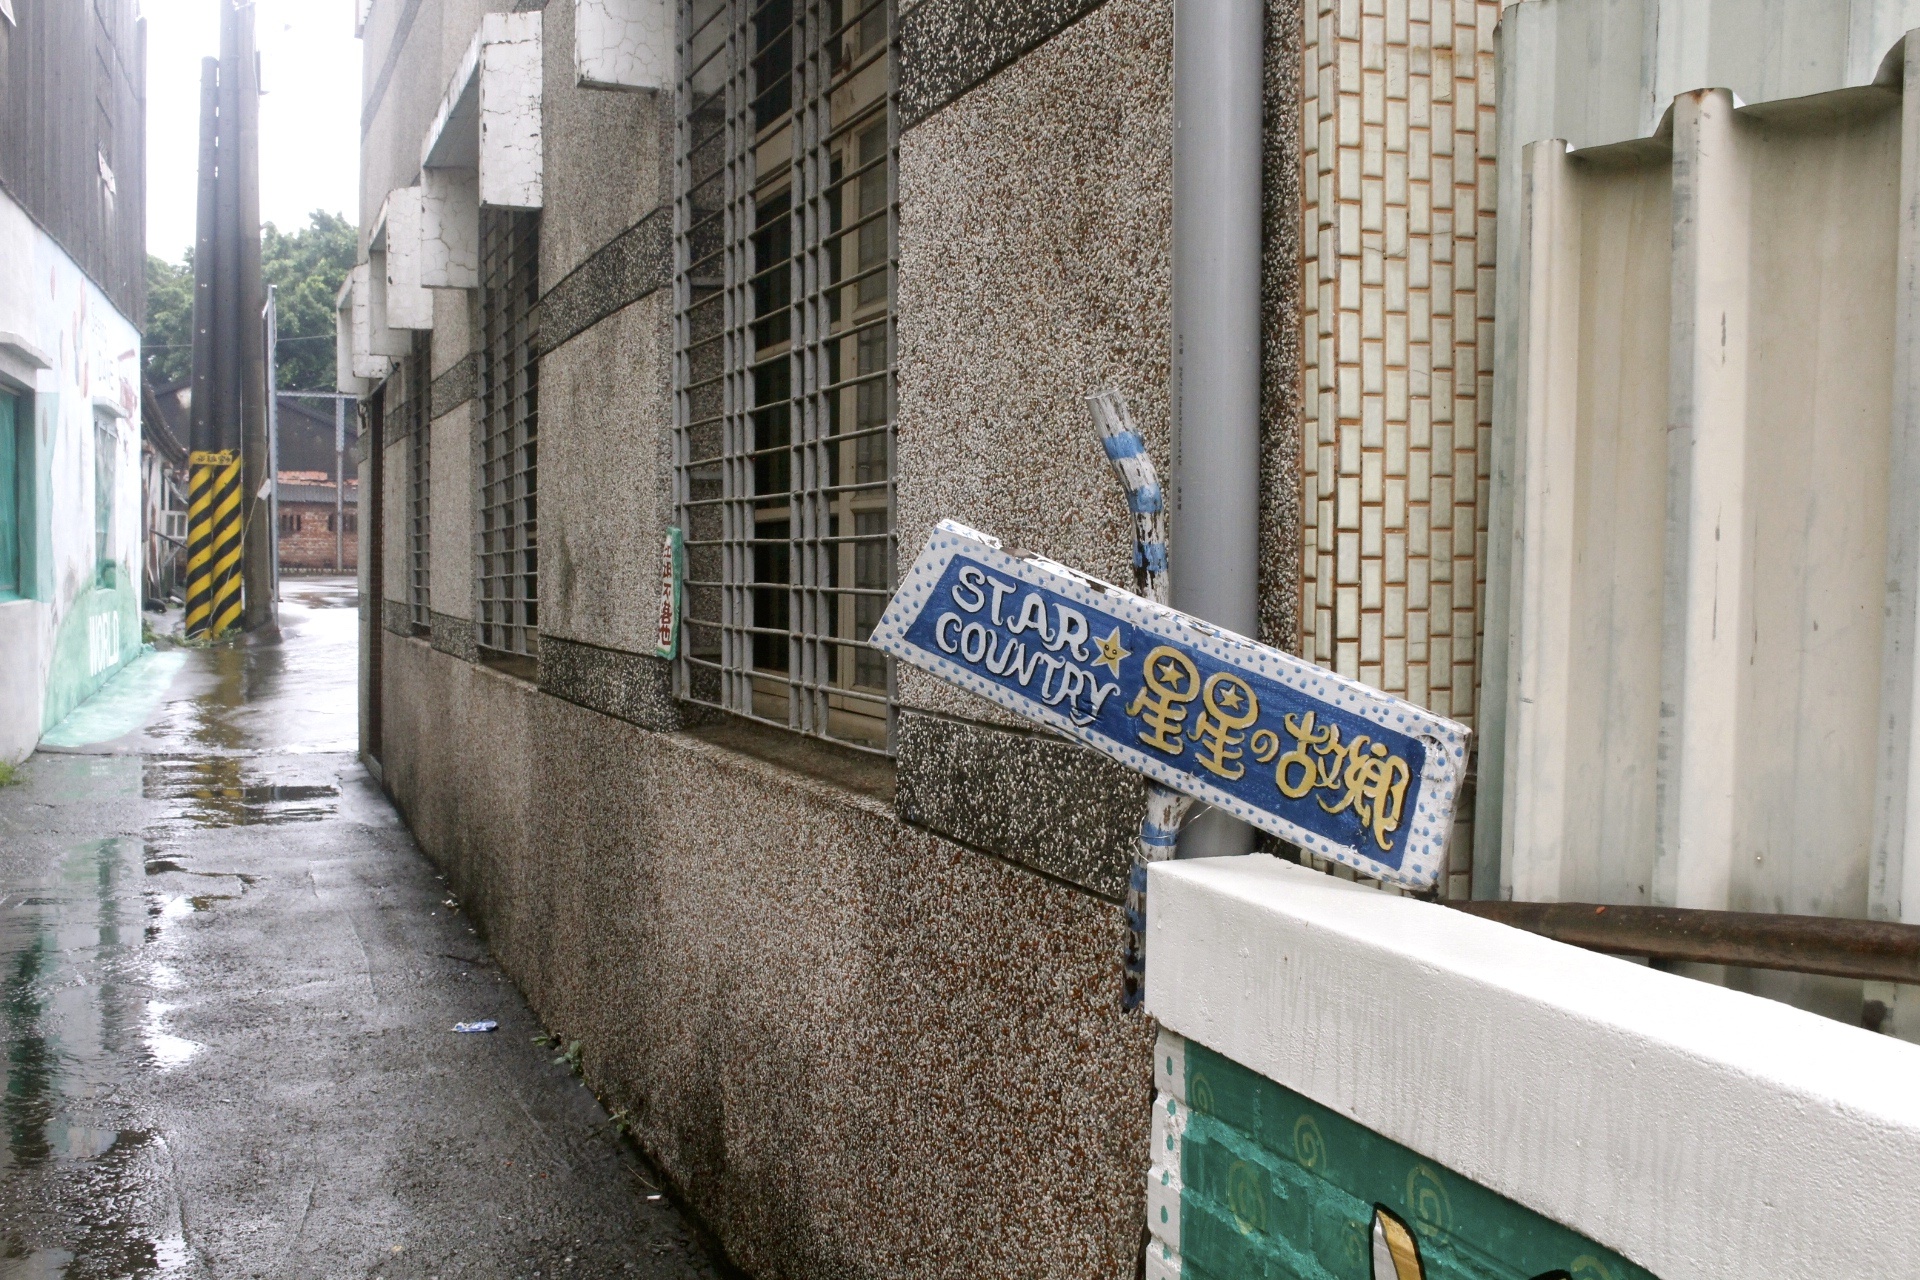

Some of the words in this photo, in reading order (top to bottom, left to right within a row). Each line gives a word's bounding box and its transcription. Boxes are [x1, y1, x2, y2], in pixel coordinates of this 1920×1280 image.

[89, 610, 119, 677] WORLD
[953, 565, 1089, 662] STAR
[936, 612, 1120, 727] COUNTRY
